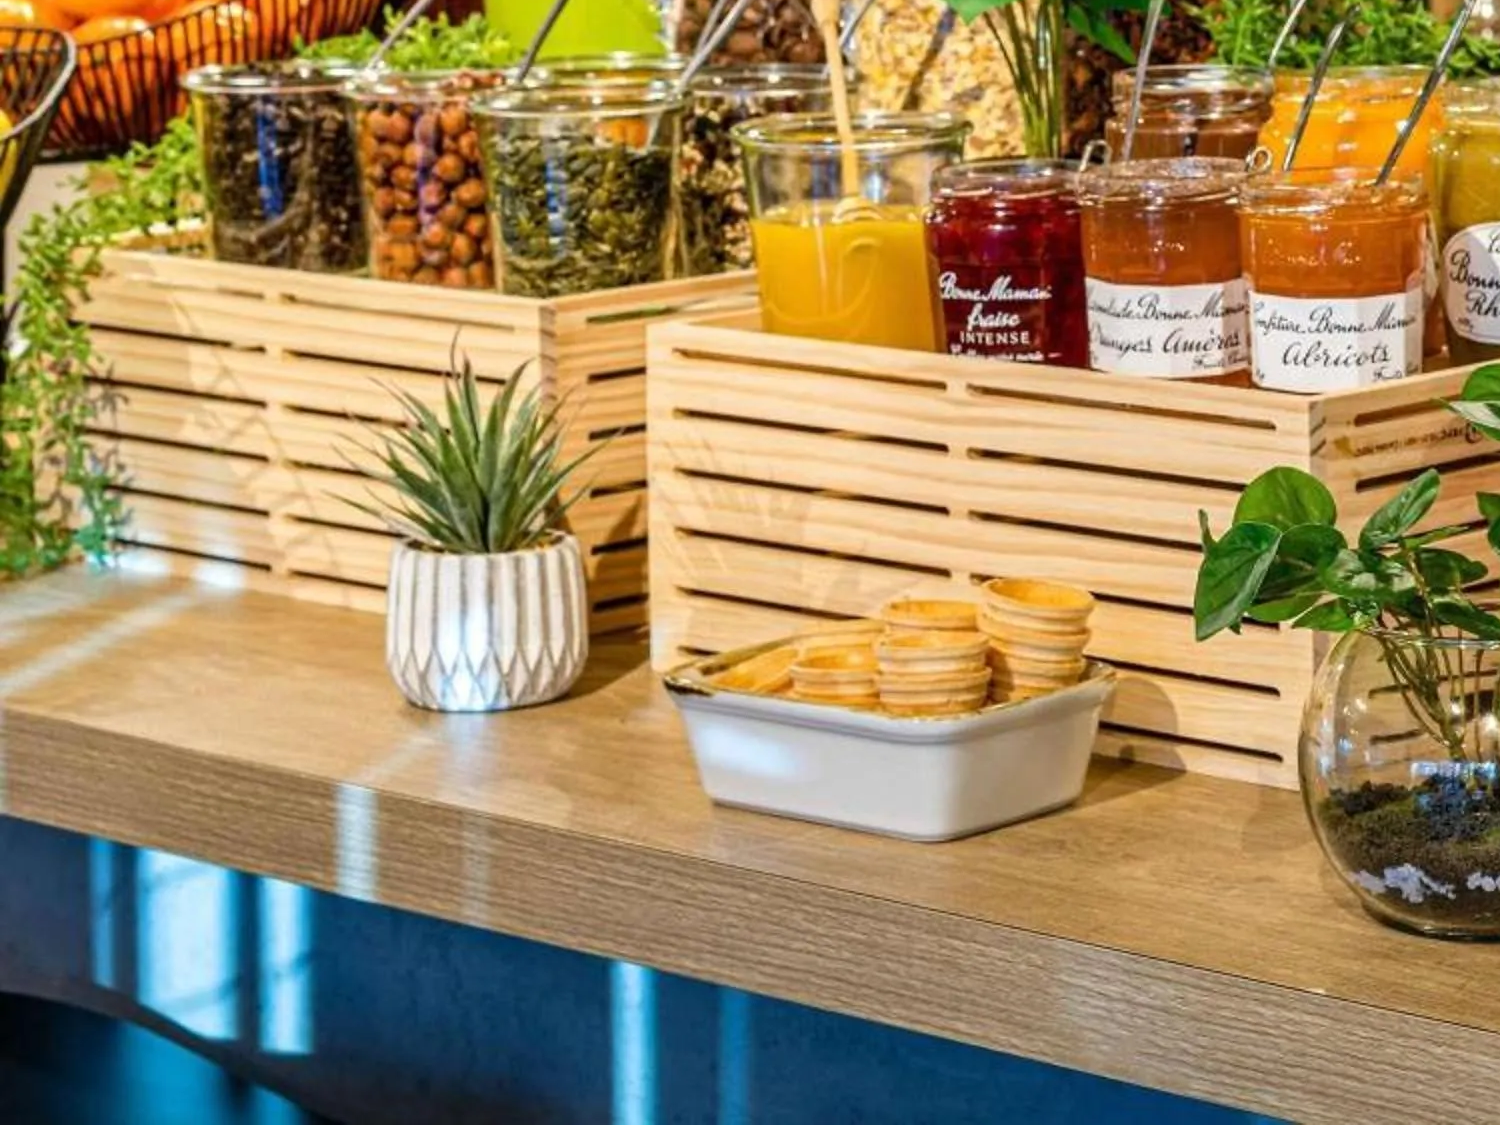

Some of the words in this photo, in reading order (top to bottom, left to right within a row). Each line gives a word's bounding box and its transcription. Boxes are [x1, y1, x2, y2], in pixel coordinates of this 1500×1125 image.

[1137, 292, 1191, 320] Bonne
[1308, 306, 1365, 334] Bonne
[960, 331, 1030, 345] INTENSE
[1282, 340, 1391, 368] Abricots
